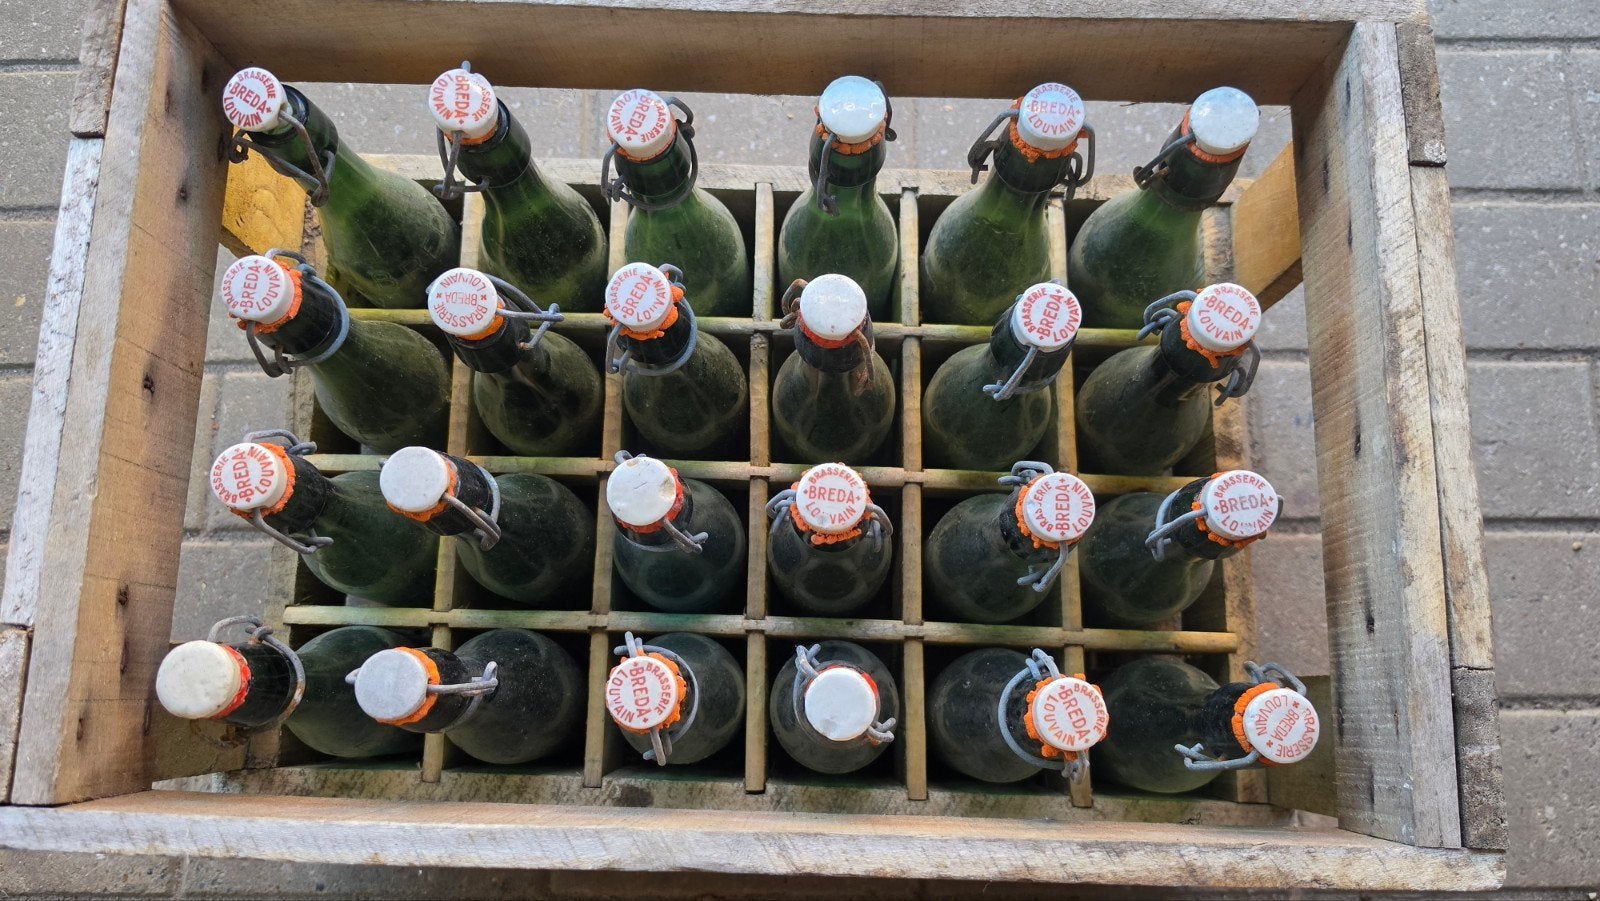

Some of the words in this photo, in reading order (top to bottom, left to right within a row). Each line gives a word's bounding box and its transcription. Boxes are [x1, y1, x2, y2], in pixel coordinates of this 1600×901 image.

[229, 83, 267, 113] BREDA
[238, 69, 276, 99] BRASSERIE
[432, 75, 455, 120] LOUVAIN
[455, 75, 470, 118] BREDA
[1031, 84, 1078, 103] BRASSERIE
[224, 97, 262, 126] LOUVAIN
[610, 91, 638, 134] LOUVAIN
[625, 95, 651, 136] BREDA
[1029, 116, 1075, 135] LOUVAIN
[1031, 100, 1075, 116] BREDA
[223, 262, 245, 308] BRASSERIE
[241, 265, 260, 308] BREDA
[257, 266, 281, 311] LOUVAIN
[612, 268, 638, 310] BRASSERIE
[622, 275, 650, 316] BREDA
[1214, 287, 1257, 316] BRASSERIE
[433, 304, 487, 328] BRASSERIE
[1023, 287, 1047, 334] BRASSERIE
[1038, 291, 1063, 337] BREDA
[1053, 298, 1079, 342] LOUVAIN
[1198, 310, 1243, 341] LOUVAIN
[1207, 295, 1250, 329] BREDA
[212, 455, 236, 503] BRASSERIE
[232, 450, 254, 499] BREDA
[248, 446, 274, 495] LOUVAIN
[808, 468, 857, 487] BRASSERIE
[1215, 475, 1265, 498] BRASSERIE
[806, 501, 856, 524] LOVAIN
[808, 486, 854, 504] BREDA
[1055, 484, 1069, 530] BREDA
[1072, 484, 1093, 532] LOUVAIN
[1219, 494, 1269, 512] BREDA
[629, 667, 651, 717] BREDA
[645, 663, 671, 716] BRASSERIE
[1074, 684, 1104, 735] BRASSERIE
[1044, 695, 1074, 746] LOUVAIN
[1058, 689, 1090, 739] BREDA
[1255, 695, 1288, 736] LOUVAIN
[1271, 711, 1299, 741] BREDA
